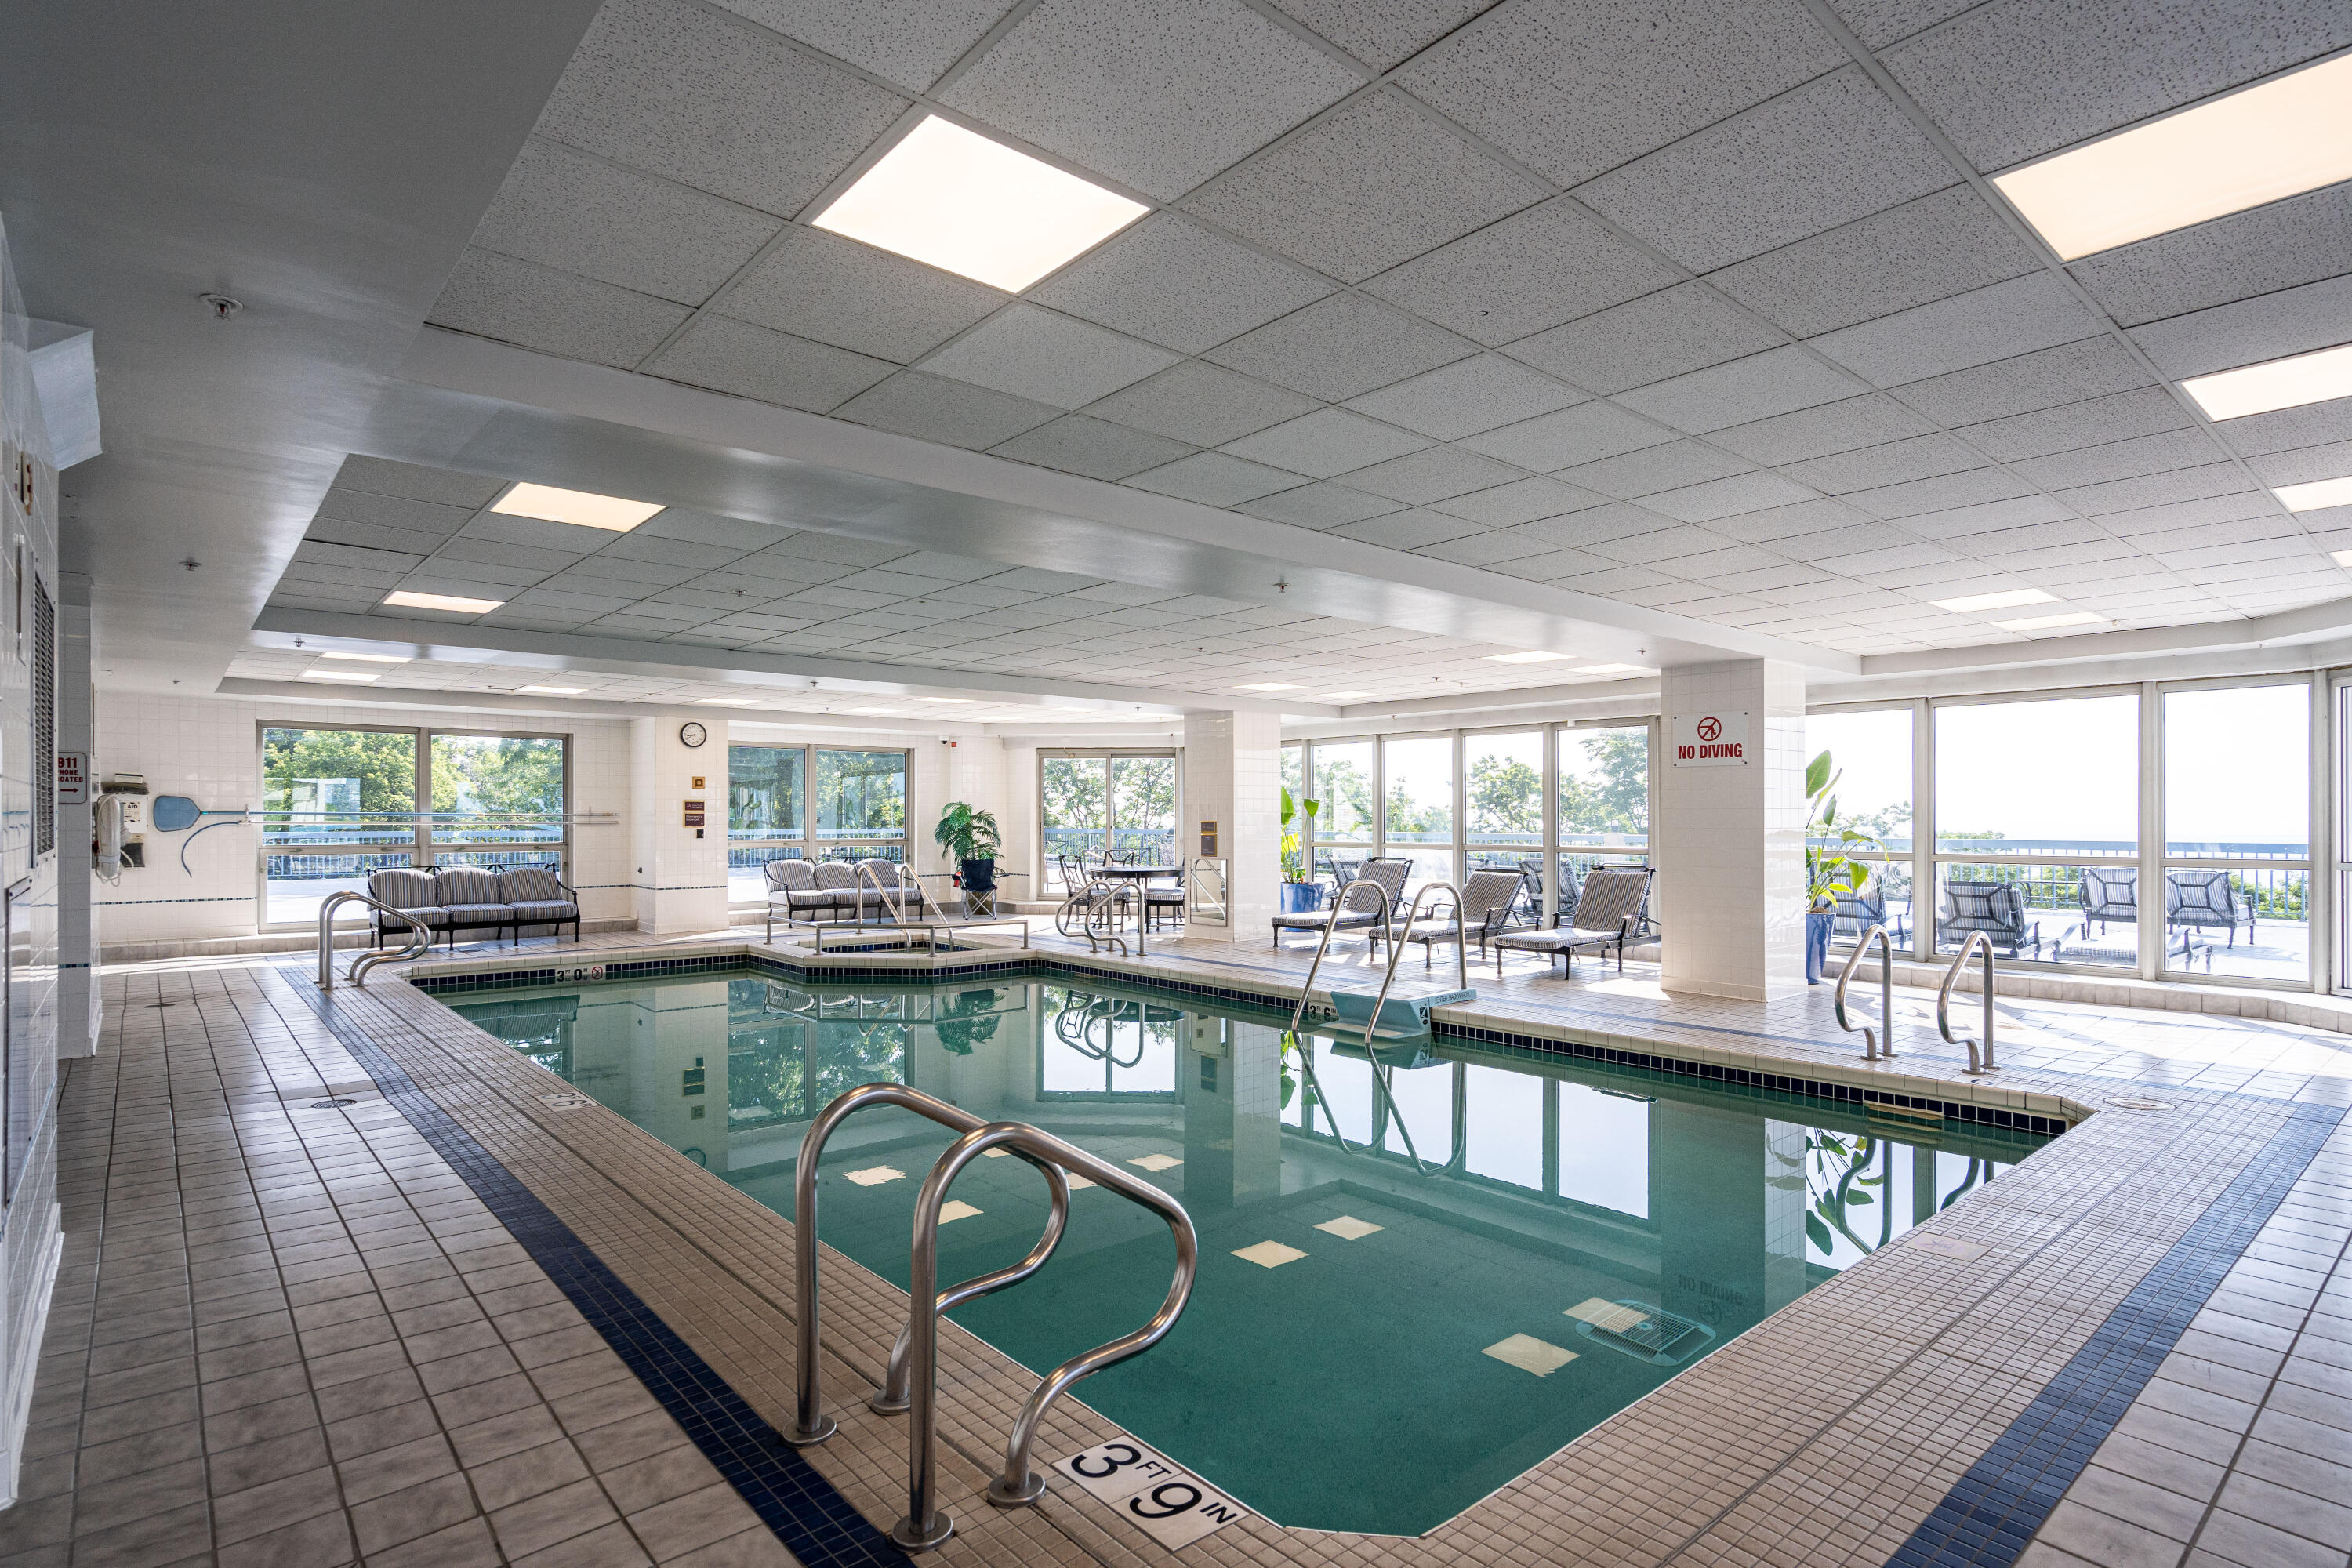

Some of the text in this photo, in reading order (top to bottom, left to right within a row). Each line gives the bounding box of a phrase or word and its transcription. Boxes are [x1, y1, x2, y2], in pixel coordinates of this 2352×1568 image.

[1678, 742, 1743, 759] NO DIVING
[58, 757, 78, 768] 911
[557, 970, 564, 982] 3
[1436, 990, 1470, 1004] ENTER BACKYARDS
[1071, 1443, 1239, 1525] 3 FT 9 IN
